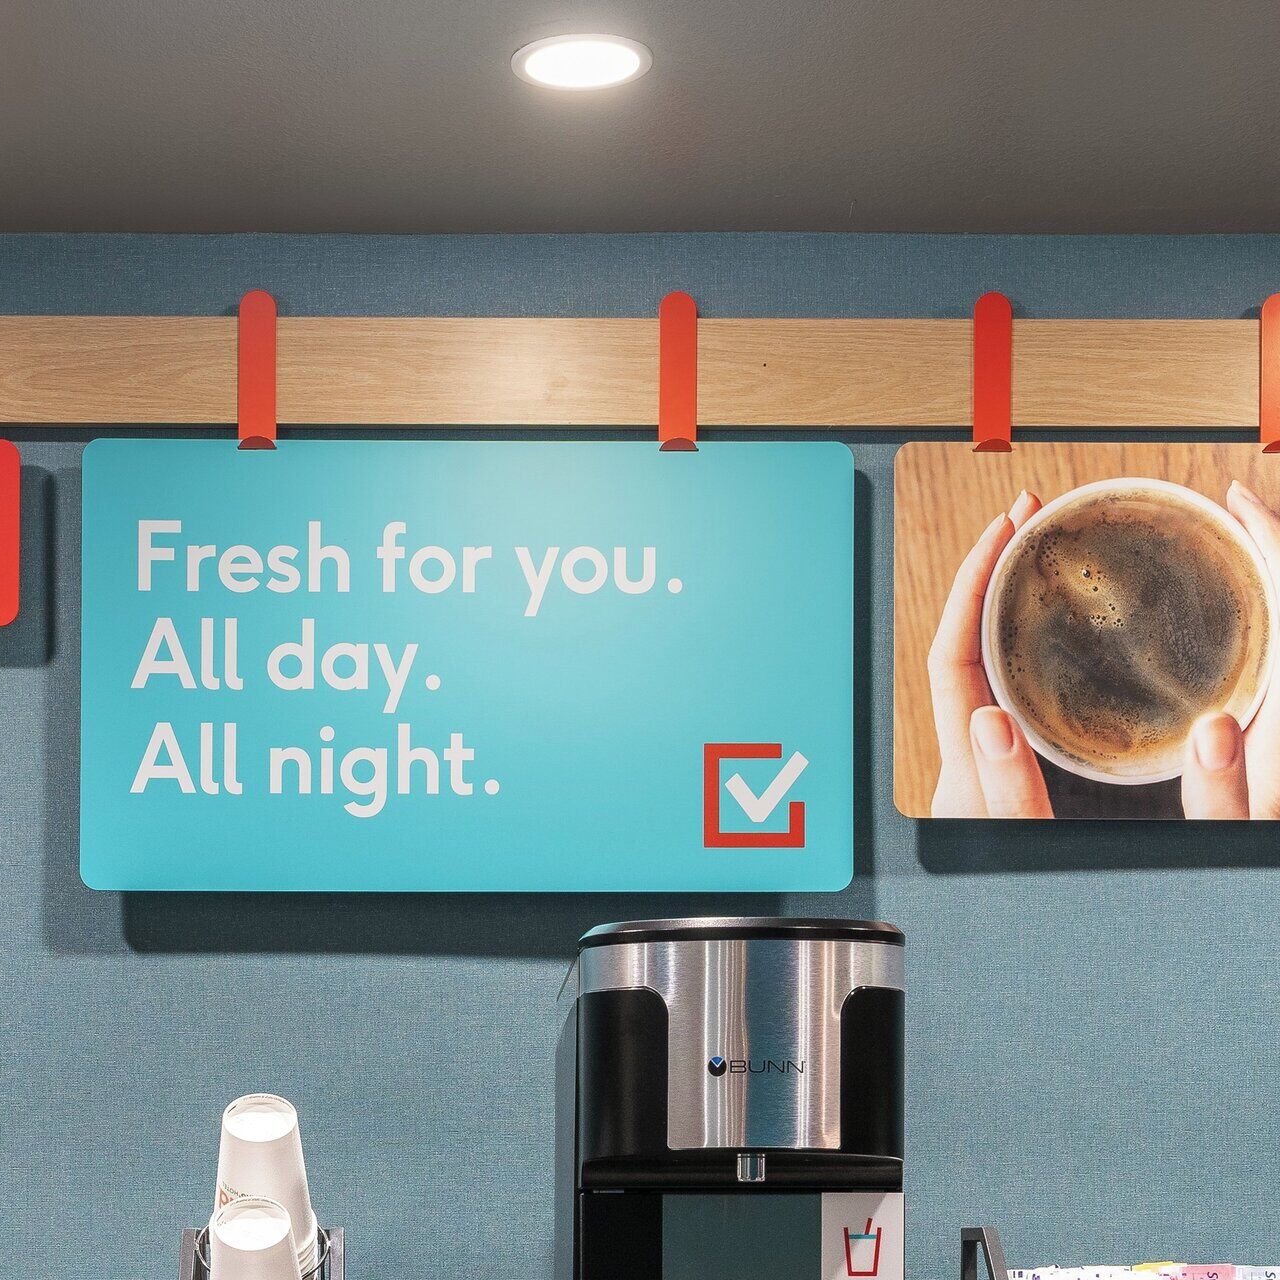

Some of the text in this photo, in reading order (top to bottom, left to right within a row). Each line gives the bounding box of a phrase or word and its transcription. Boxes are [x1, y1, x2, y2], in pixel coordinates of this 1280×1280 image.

[138, 520, 683, 617] Fresh for you.
[130, 618, 441, 713] All day.
[129, 722, 500, 818] All night.
[730, 1061, 804, 1073] BUNN
